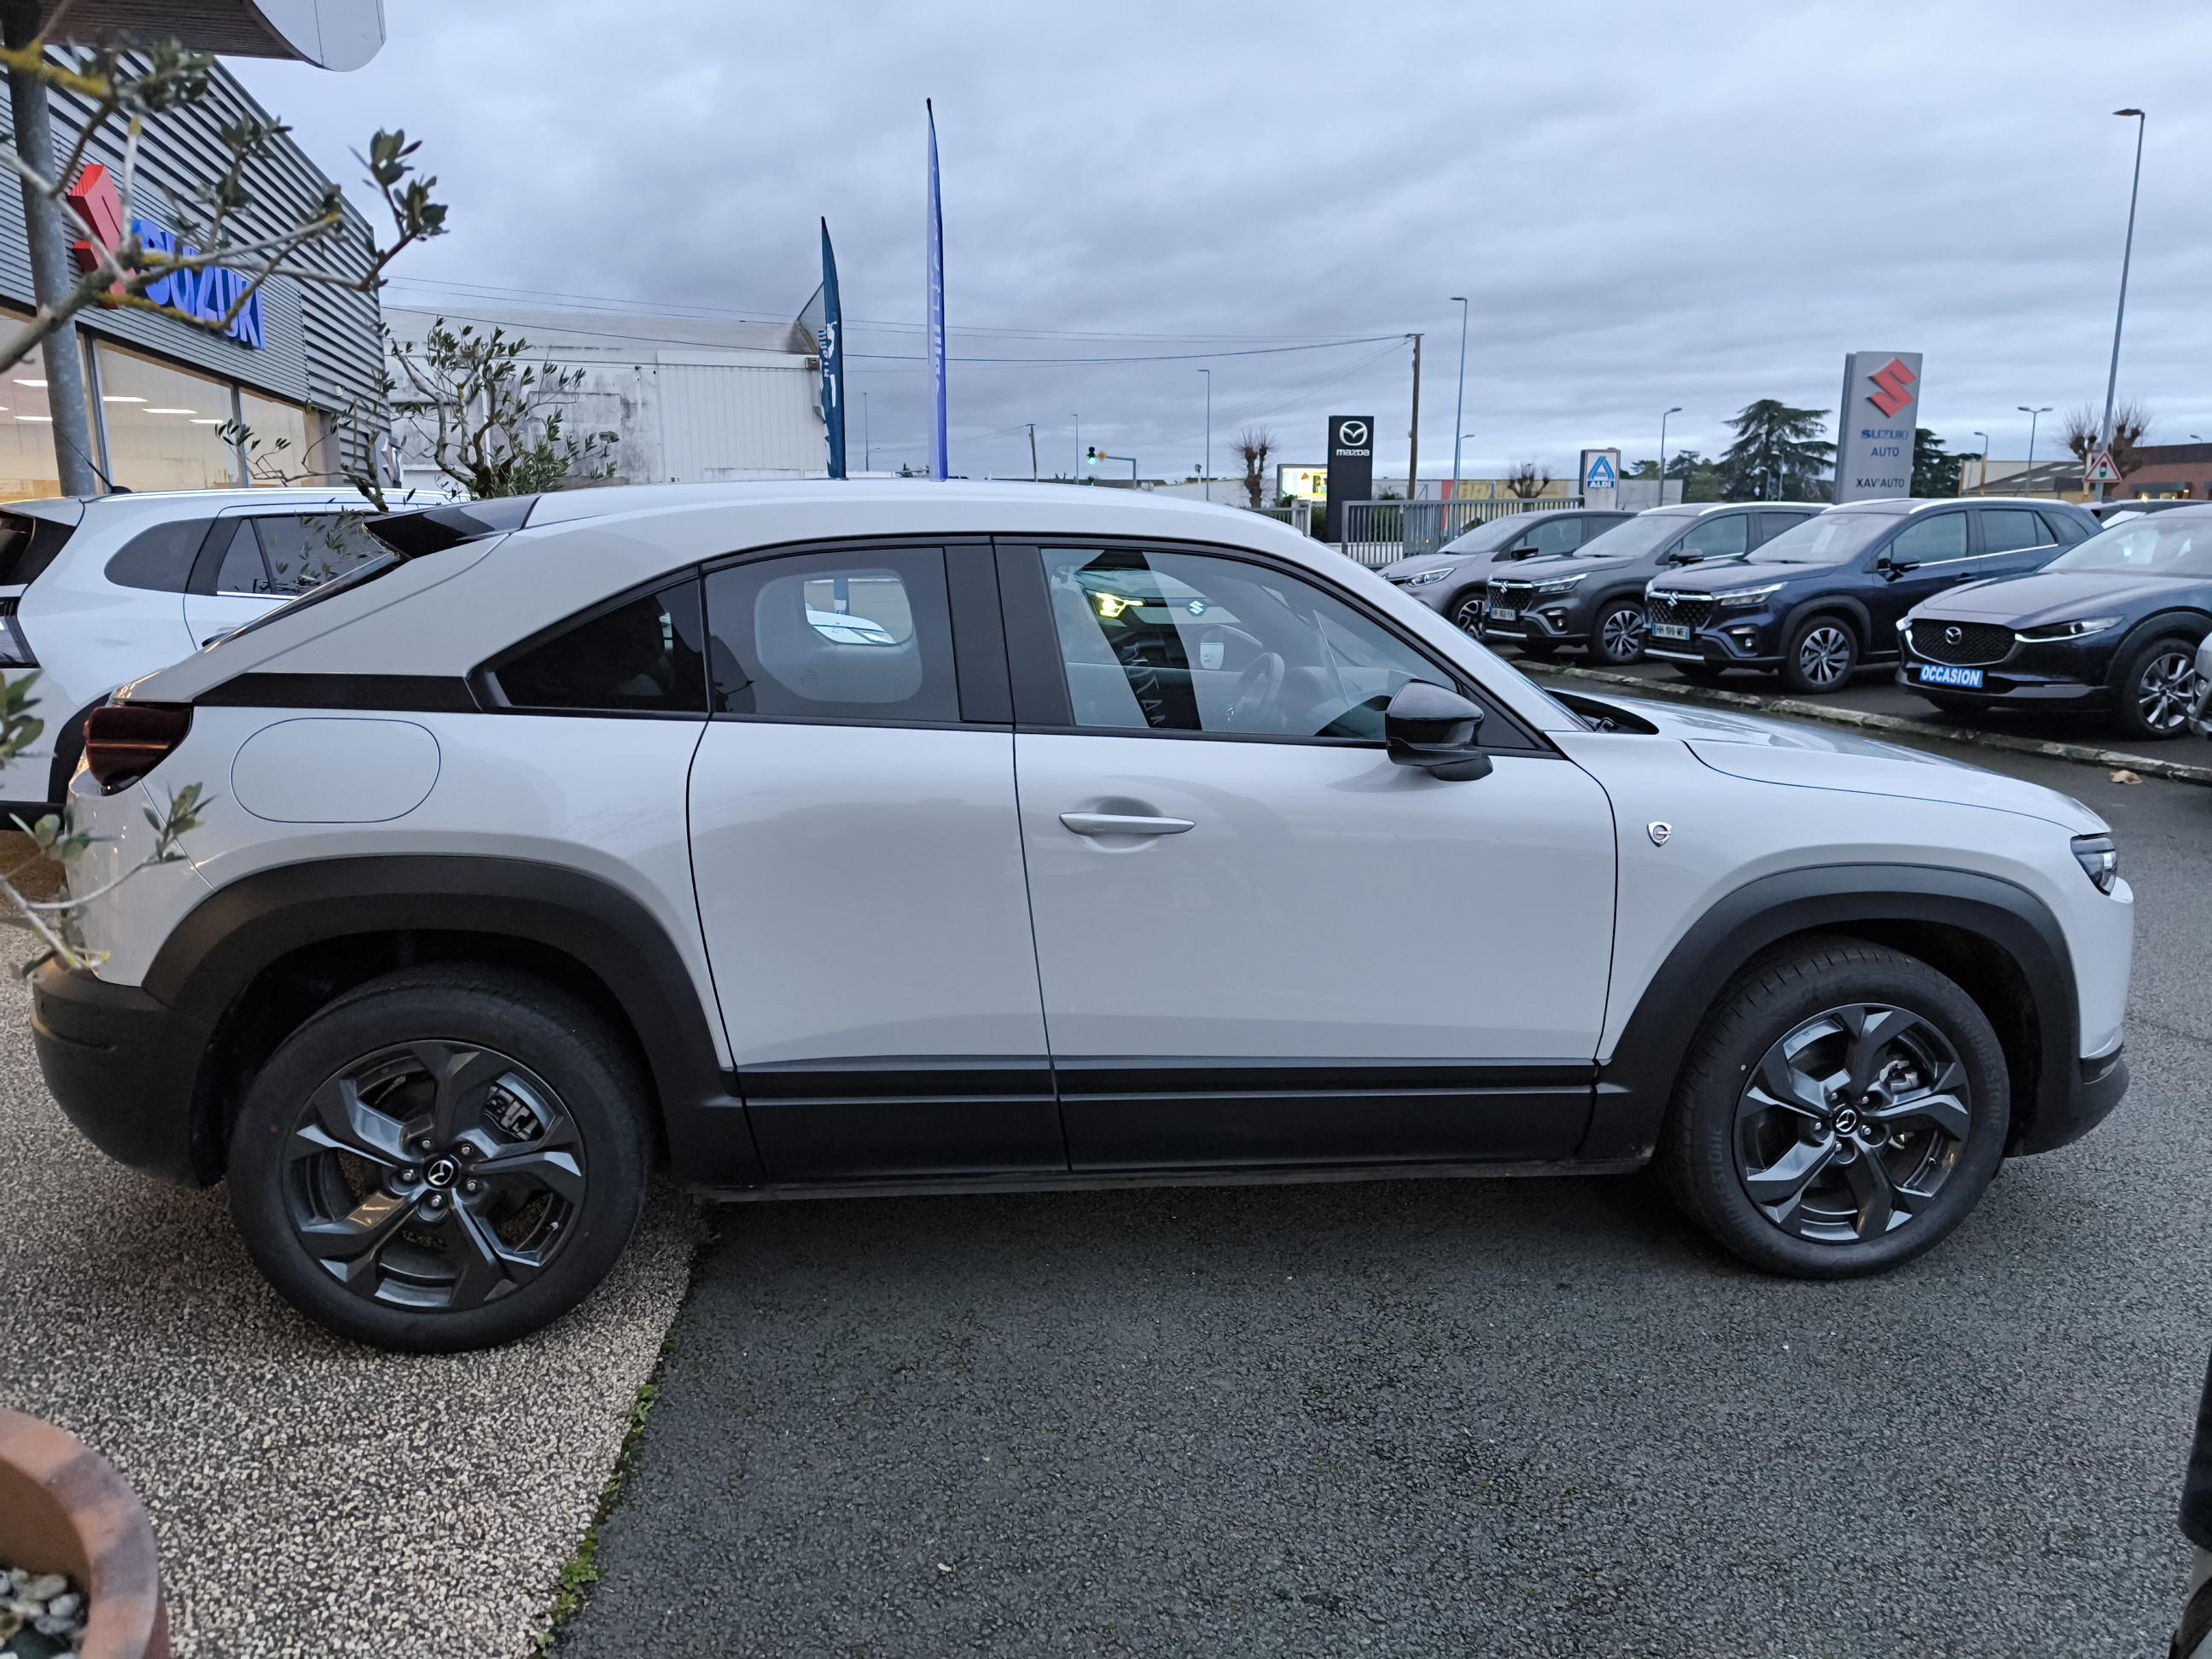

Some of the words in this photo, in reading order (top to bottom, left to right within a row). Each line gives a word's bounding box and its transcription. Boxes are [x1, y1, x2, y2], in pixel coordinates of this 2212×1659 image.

[1860, 429, 1909, 439] SUZUKI
[1871, 446, 1900, 457] AUTO
[1855, 477, 1906, 488] XAV'AUTO
[1921, 665, 1981, 686] OCCASION
